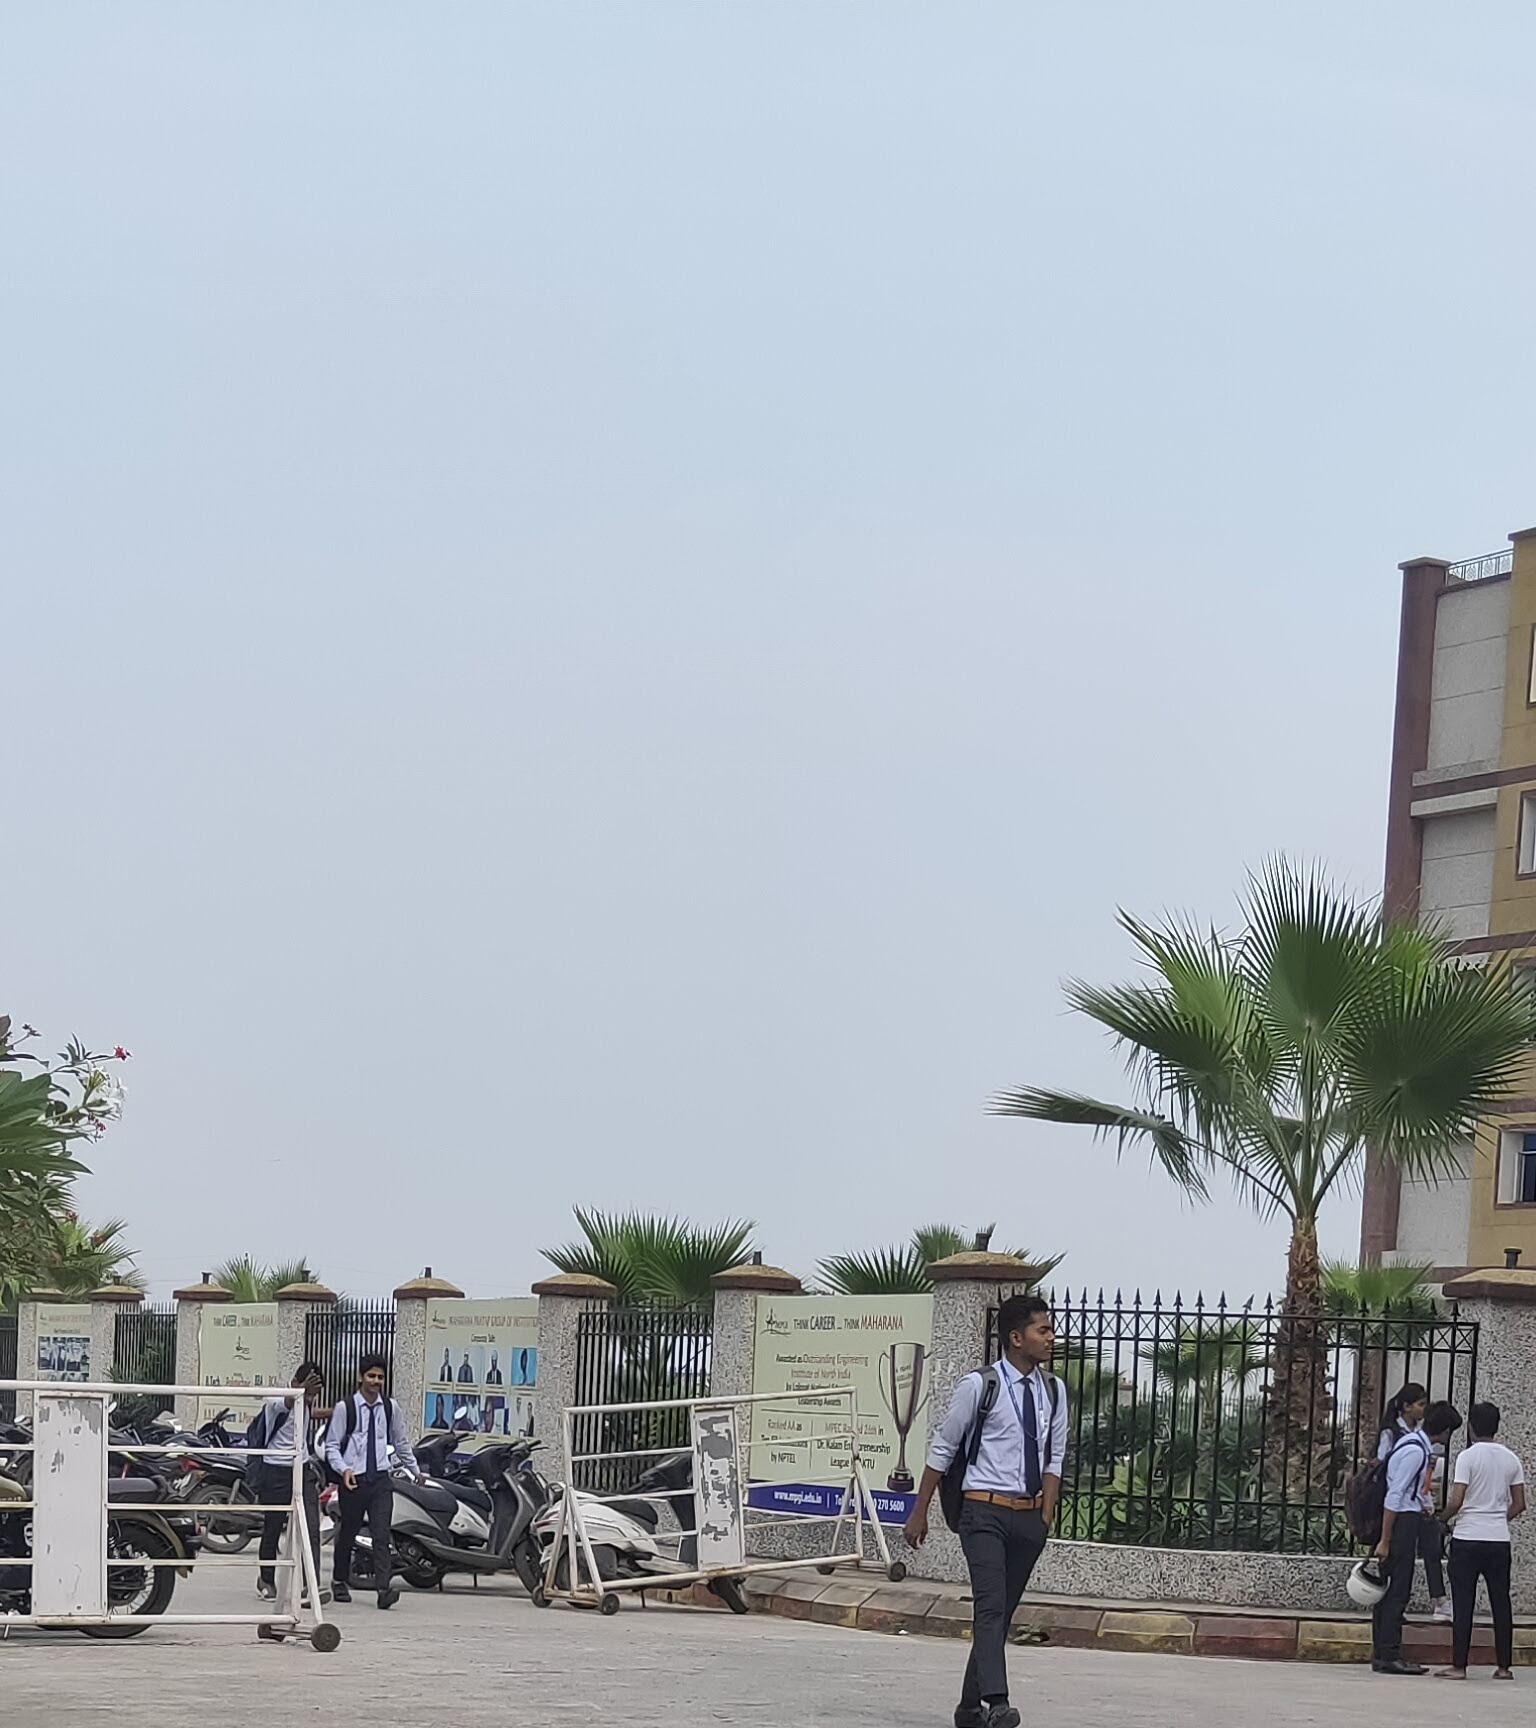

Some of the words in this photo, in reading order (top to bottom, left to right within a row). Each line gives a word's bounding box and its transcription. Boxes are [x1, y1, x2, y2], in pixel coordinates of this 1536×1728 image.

[809, 1315, 836, 1331] CAREER
[860, 1314, 904, 1331] MAHARANA
[877, 1499, 889, 1511] 270
